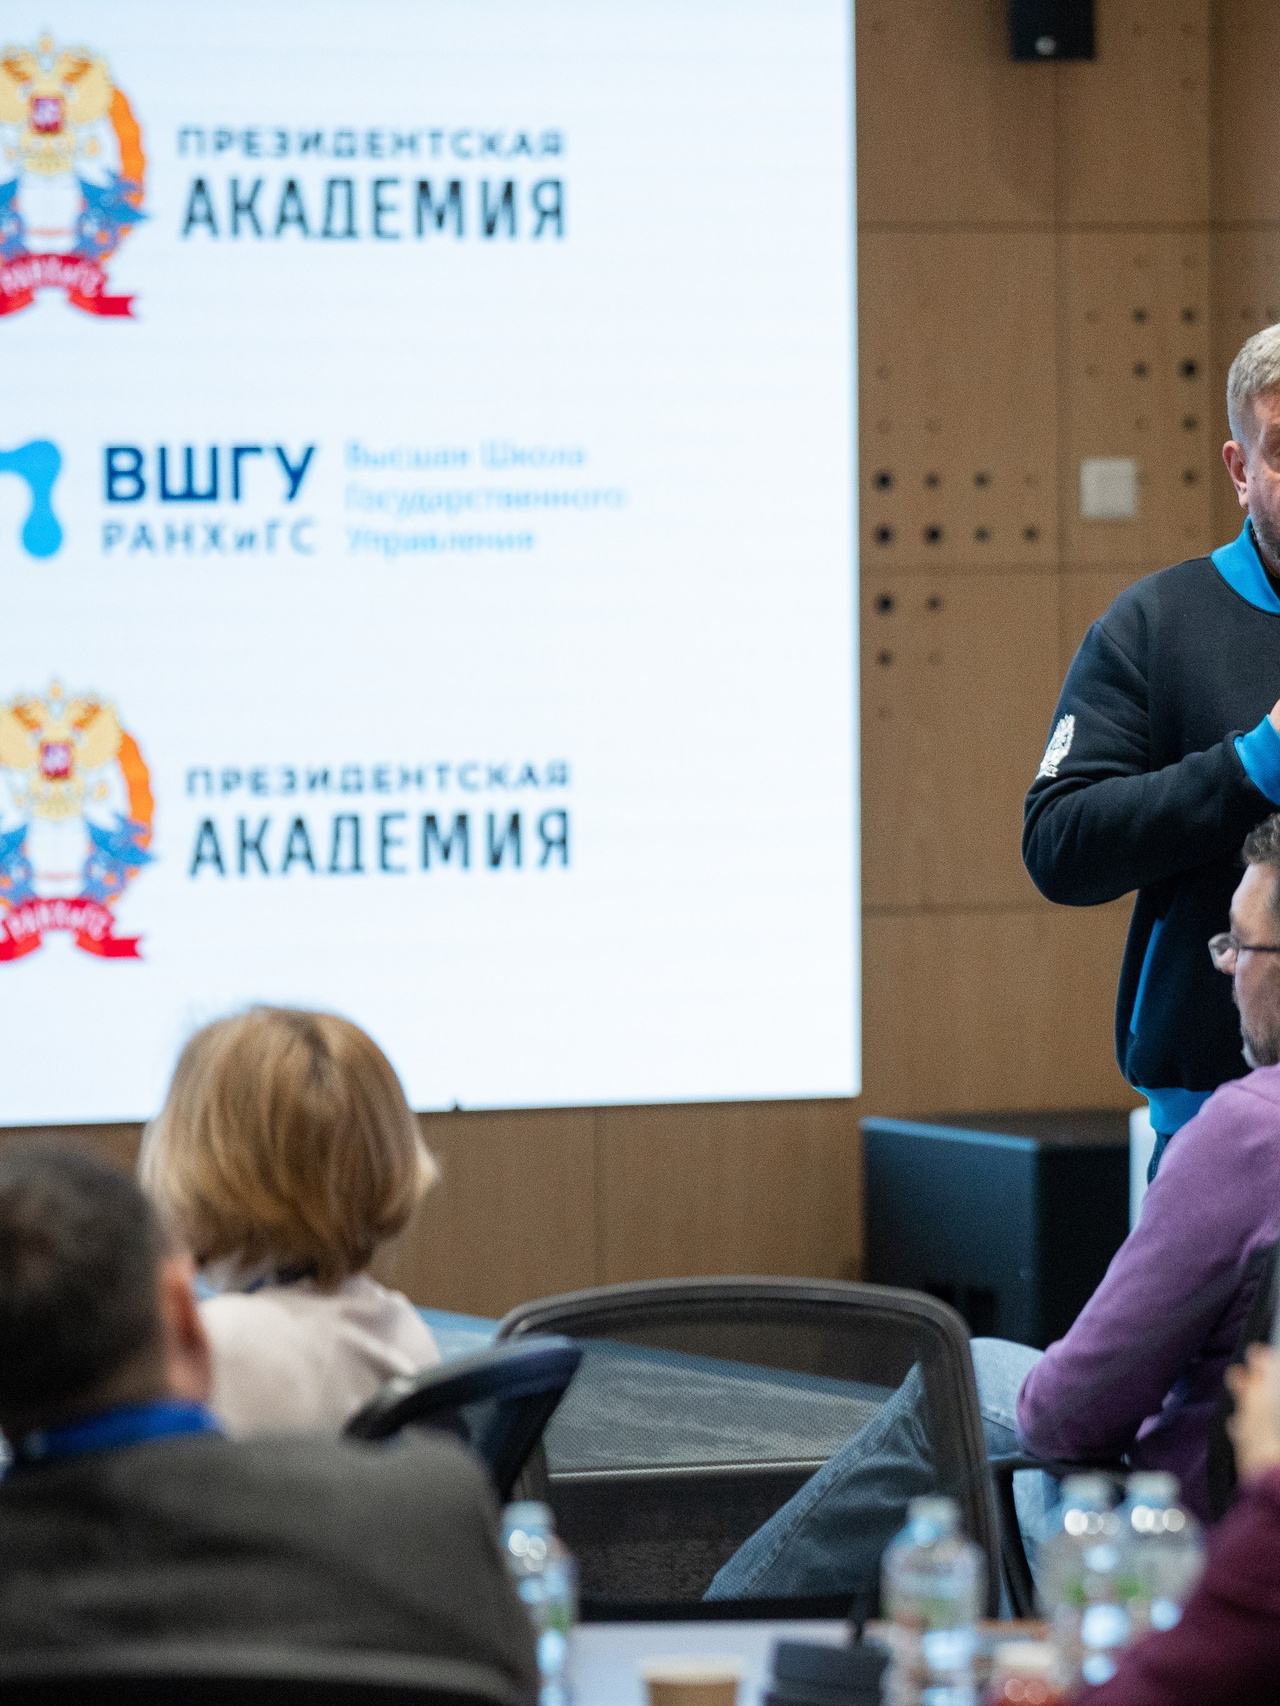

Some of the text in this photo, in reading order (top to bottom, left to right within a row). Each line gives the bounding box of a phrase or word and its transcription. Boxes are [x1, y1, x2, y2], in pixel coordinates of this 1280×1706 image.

[178, 127, 565, 159] ПРЕЗИДЕНТСКАЯ
[181, 175, 566, 241] АКАДЕМИЯ
[103, 443, 316, 503] ВШГУ
[102, 518, 317, 556] РАНХиГС
[186, 760, 569, 795] ПРЕЗИДЕНТСКАЯ
[187, 809, 569, 877] АКАДЕМИЯ
